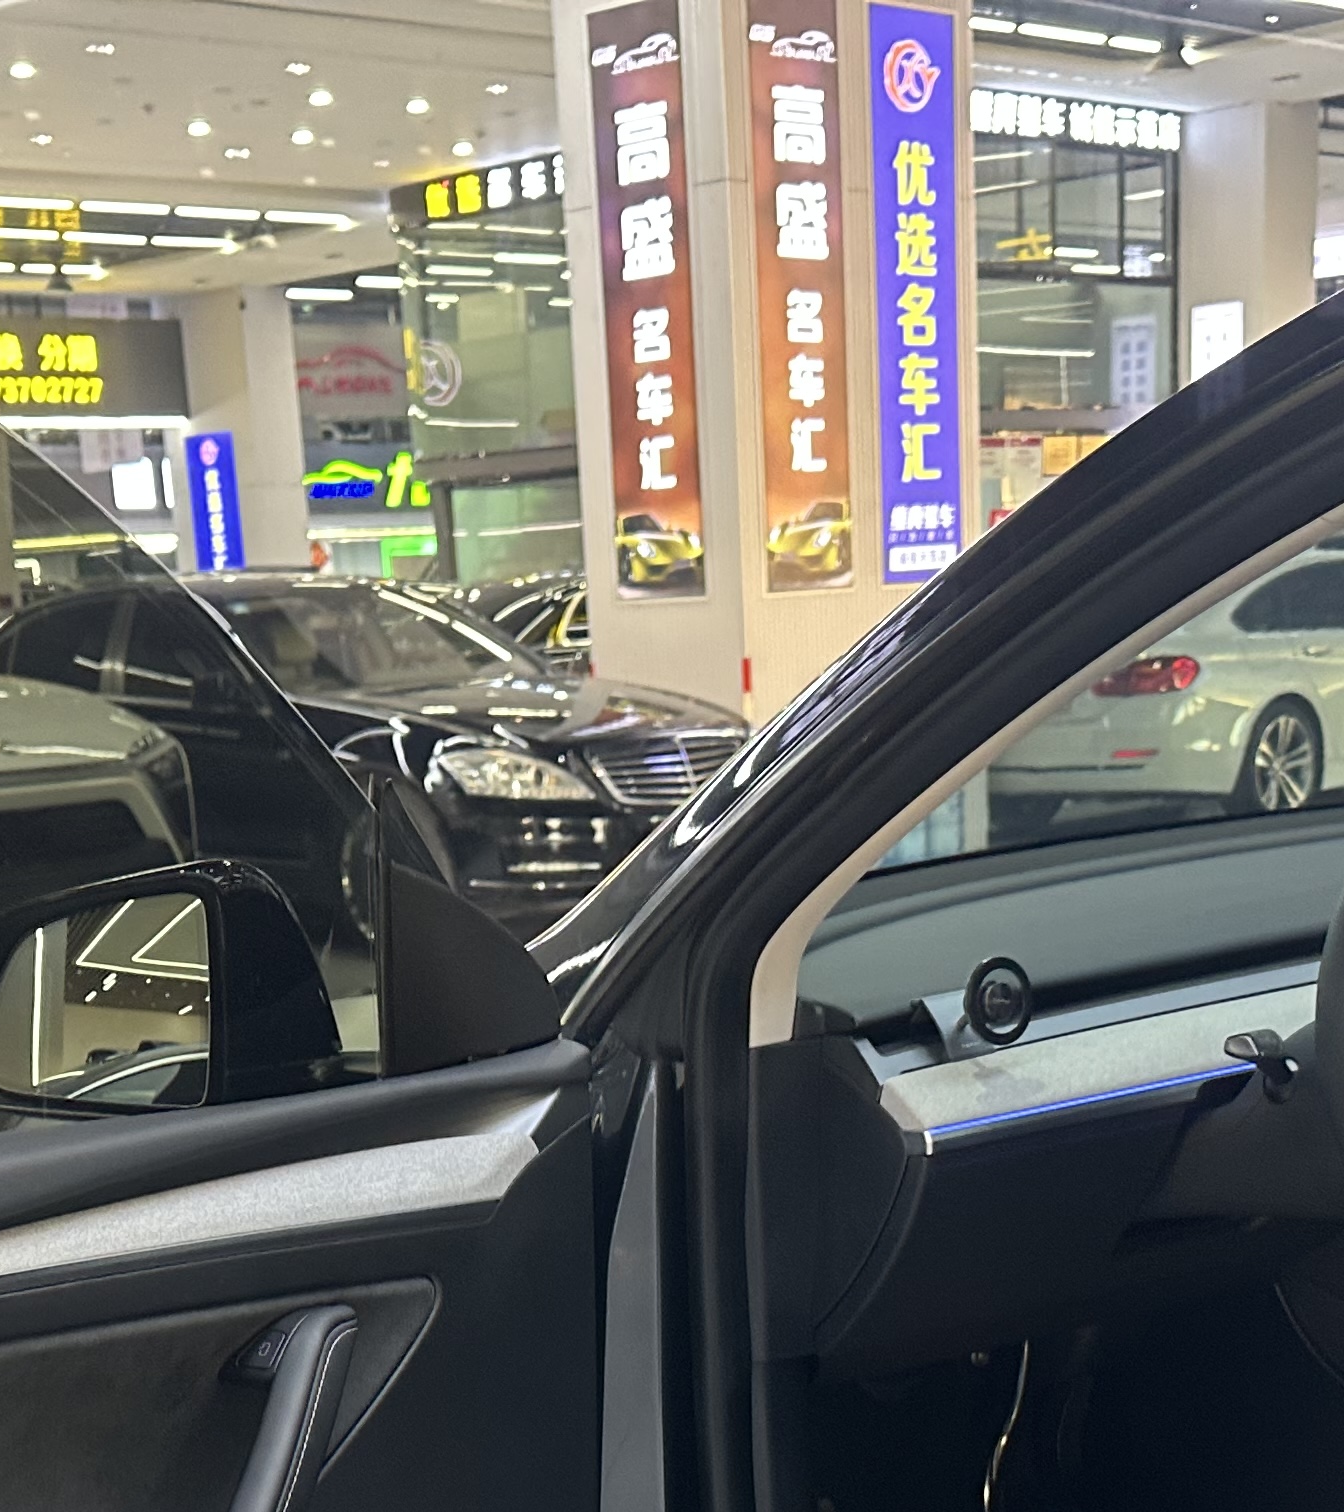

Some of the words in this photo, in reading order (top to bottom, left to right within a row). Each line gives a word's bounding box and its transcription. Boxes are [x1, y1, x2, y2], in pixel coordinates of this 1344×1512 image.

[892, 140, 943, 483] 优选名车汇
